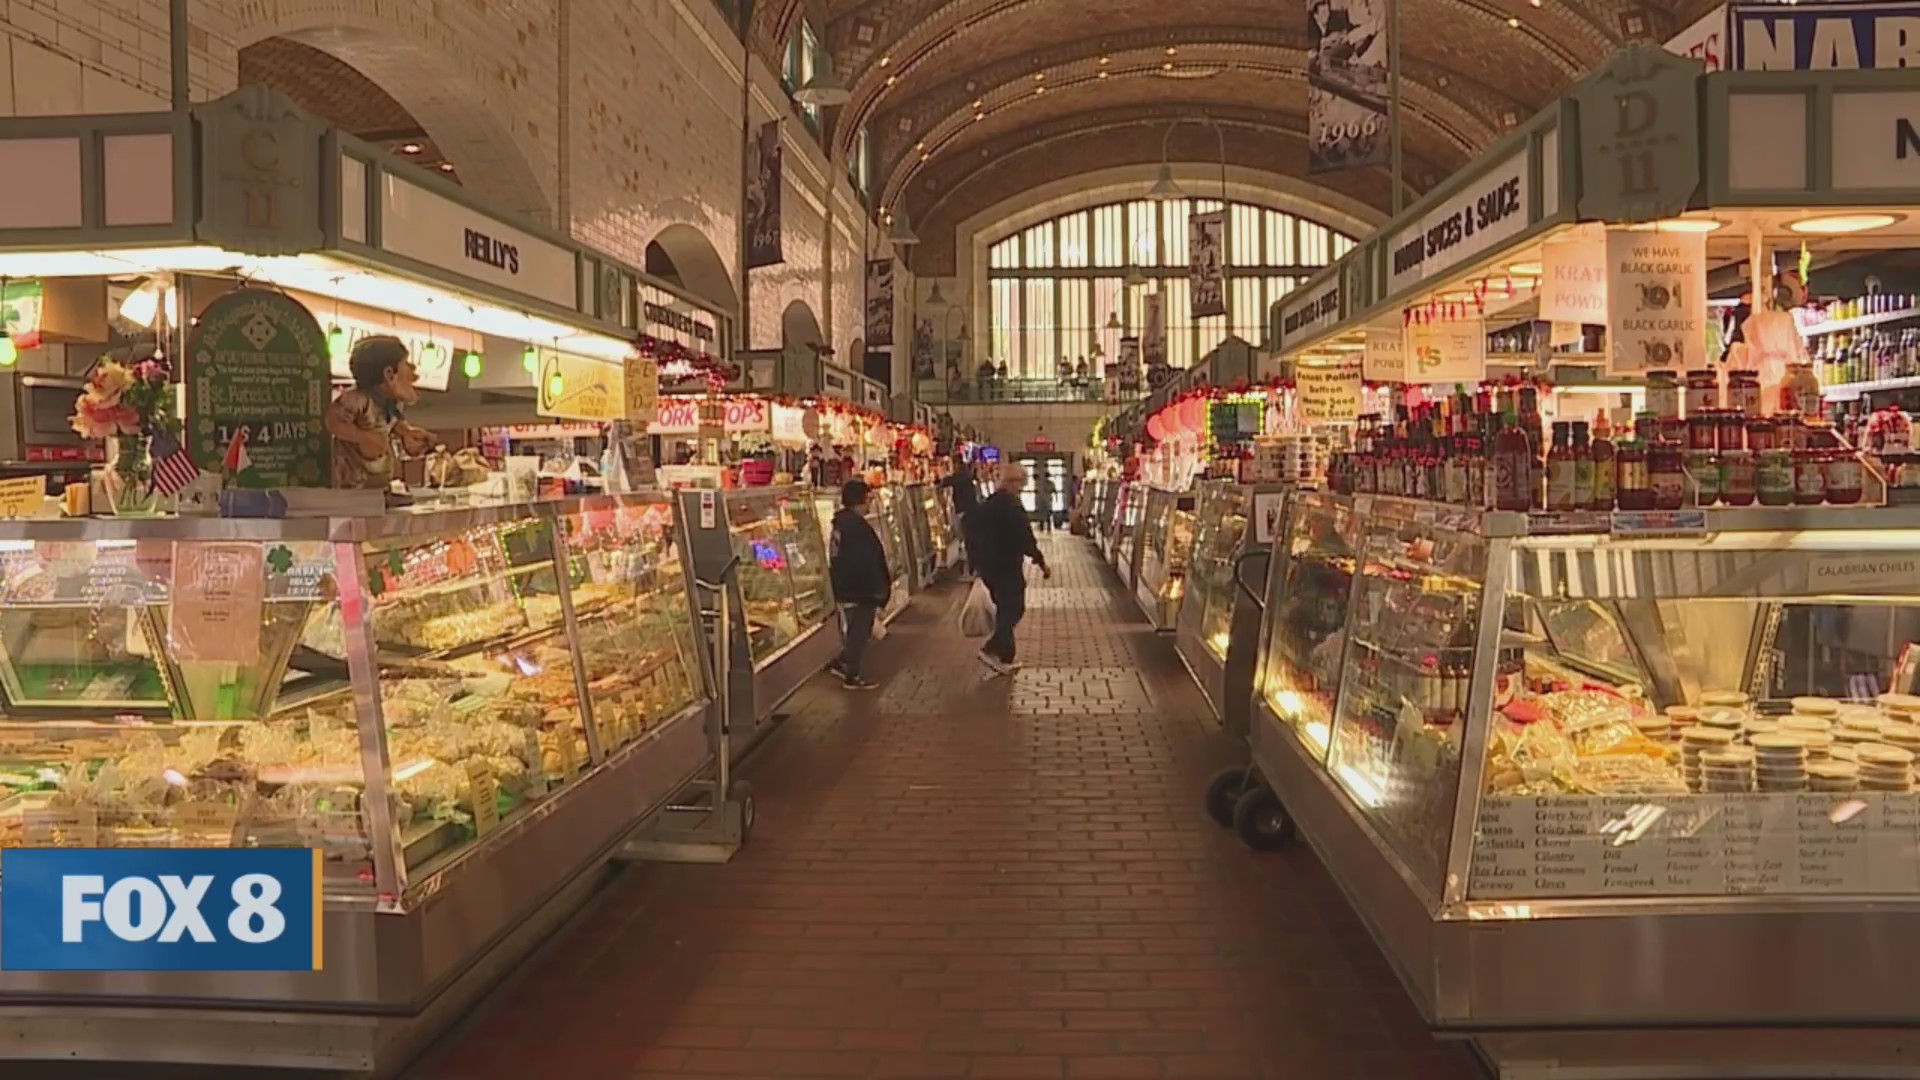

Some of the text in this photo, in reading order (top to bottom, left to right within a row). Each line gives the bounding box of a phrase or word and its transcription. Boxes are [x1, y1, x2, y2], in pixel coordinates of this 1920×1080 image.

[1614, 92, 1658, 138] D
[240, 128, 280, 172] C
[1616, 153, 1658, 195] 11
[240, 188, 281, 229] 11
[1427, 212, 1462, 258] SPICES
[1465, 206, 1474, 237] &
[1477, 176, 1520, 230] SAUCE
[464, 227, 519, 275] REILLY'S
[1632, 247, 1680, 257] WE HAVE
[1621, 263, 1693, 274] BLACK GARLIC
[1623, 320, 1696, 330] BLACK GARLIC
[1325, 372, 1360, 381] Pollen
[1329, 396, 1355, 405] Seed
[660, 407, 694, 426] ORK
[1328, 408, 1353, 417] Seed
[274, 422, 307, 439] DAYS
[1817, 562, 1916, 576] CALABRIAN CHILES
[1604, 864, 1638, 873] Fennel
